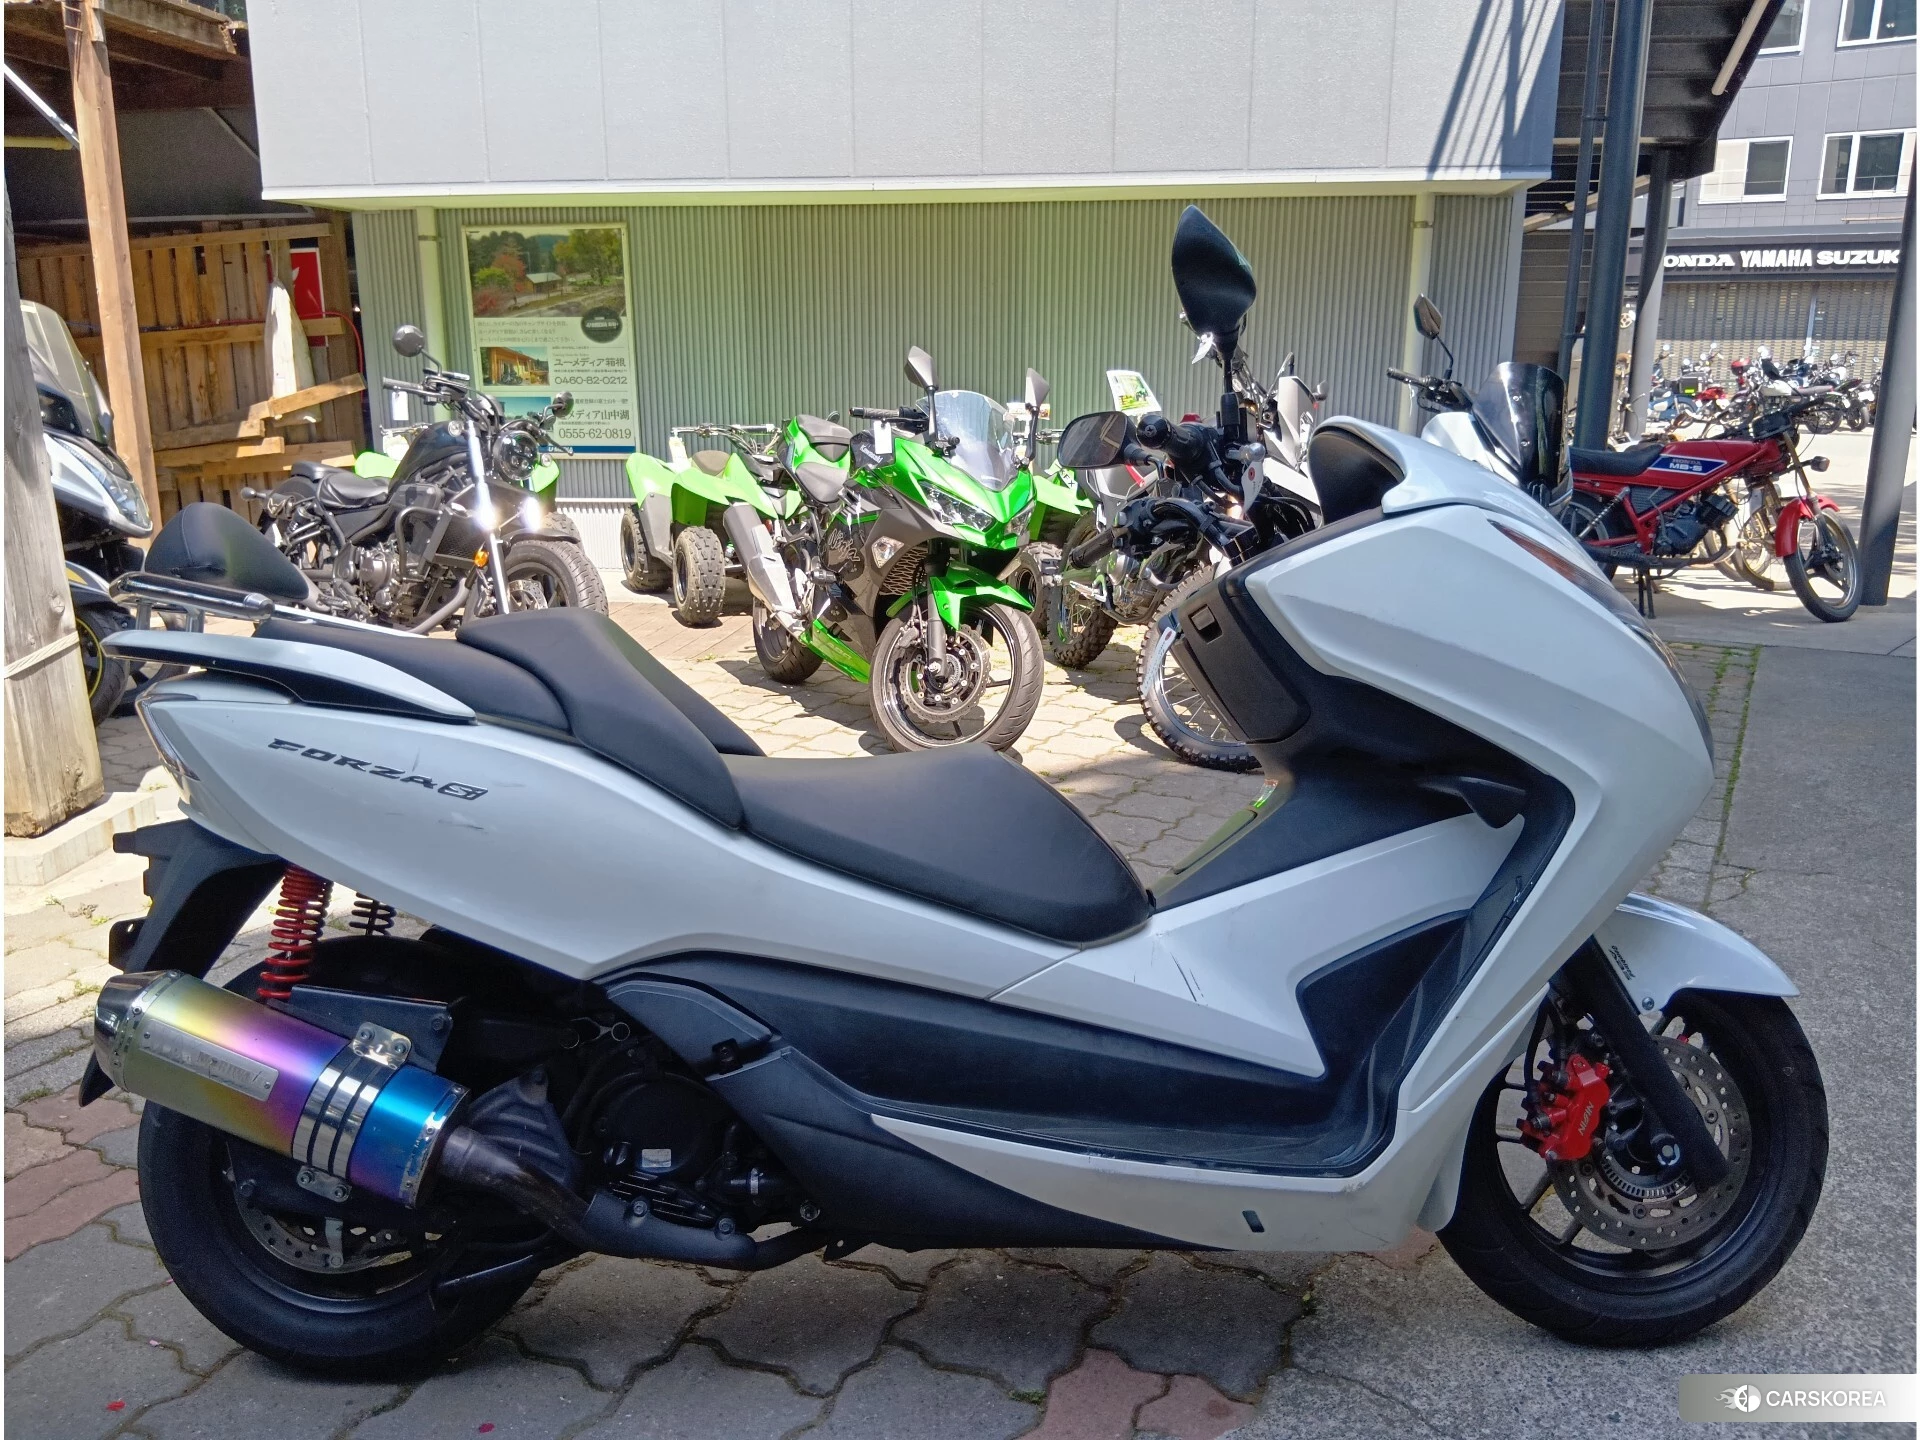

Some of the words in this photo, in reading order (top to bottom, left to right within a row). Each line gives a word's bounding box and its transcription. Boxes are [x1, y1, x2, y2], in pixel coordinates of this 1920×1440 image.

[1663, 254, 1735, 267] ONDA
[1740, 249, 1813, 267] YAMAHA
[1816, 249, 1901, 265] SUZUK
[554, 357, 626, 367] ユーメディア箱根
[554, 376, 628, 385] 0460-82-0212
[559, 409, 630, 420] メディア山中湖
[559, 428, 632, 439] 0555-62-0819
[828, 528, 860, 562] Ninja
[267, 738, 438, 789] FORZA
